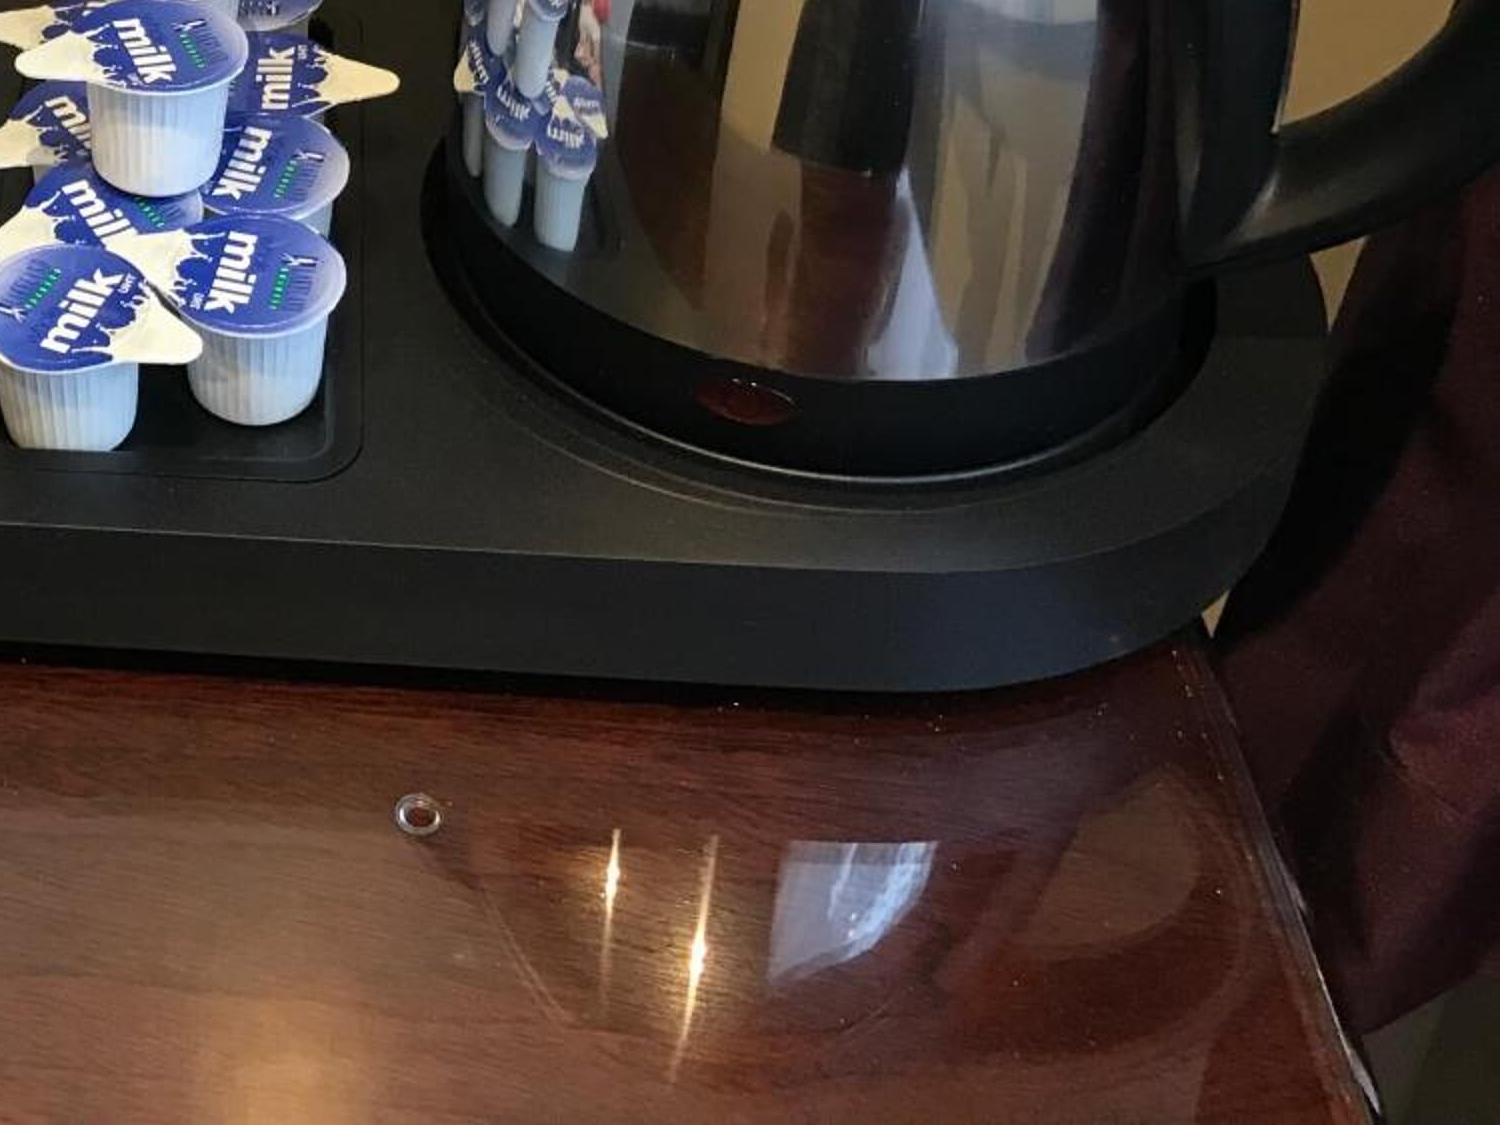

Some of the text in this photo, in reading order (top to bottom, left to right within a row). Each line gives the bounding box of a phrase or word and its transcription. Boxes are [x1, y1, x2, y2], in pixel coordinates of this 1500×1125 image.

[111, 18, 177, 85] milk
[257, 44, 296, 111] milk
[211, 125, 273, 201] milk
[61, 179, 139, 238] mil
[202, 229, 259, 315] milk
[39, 267, 127, 355] milk
